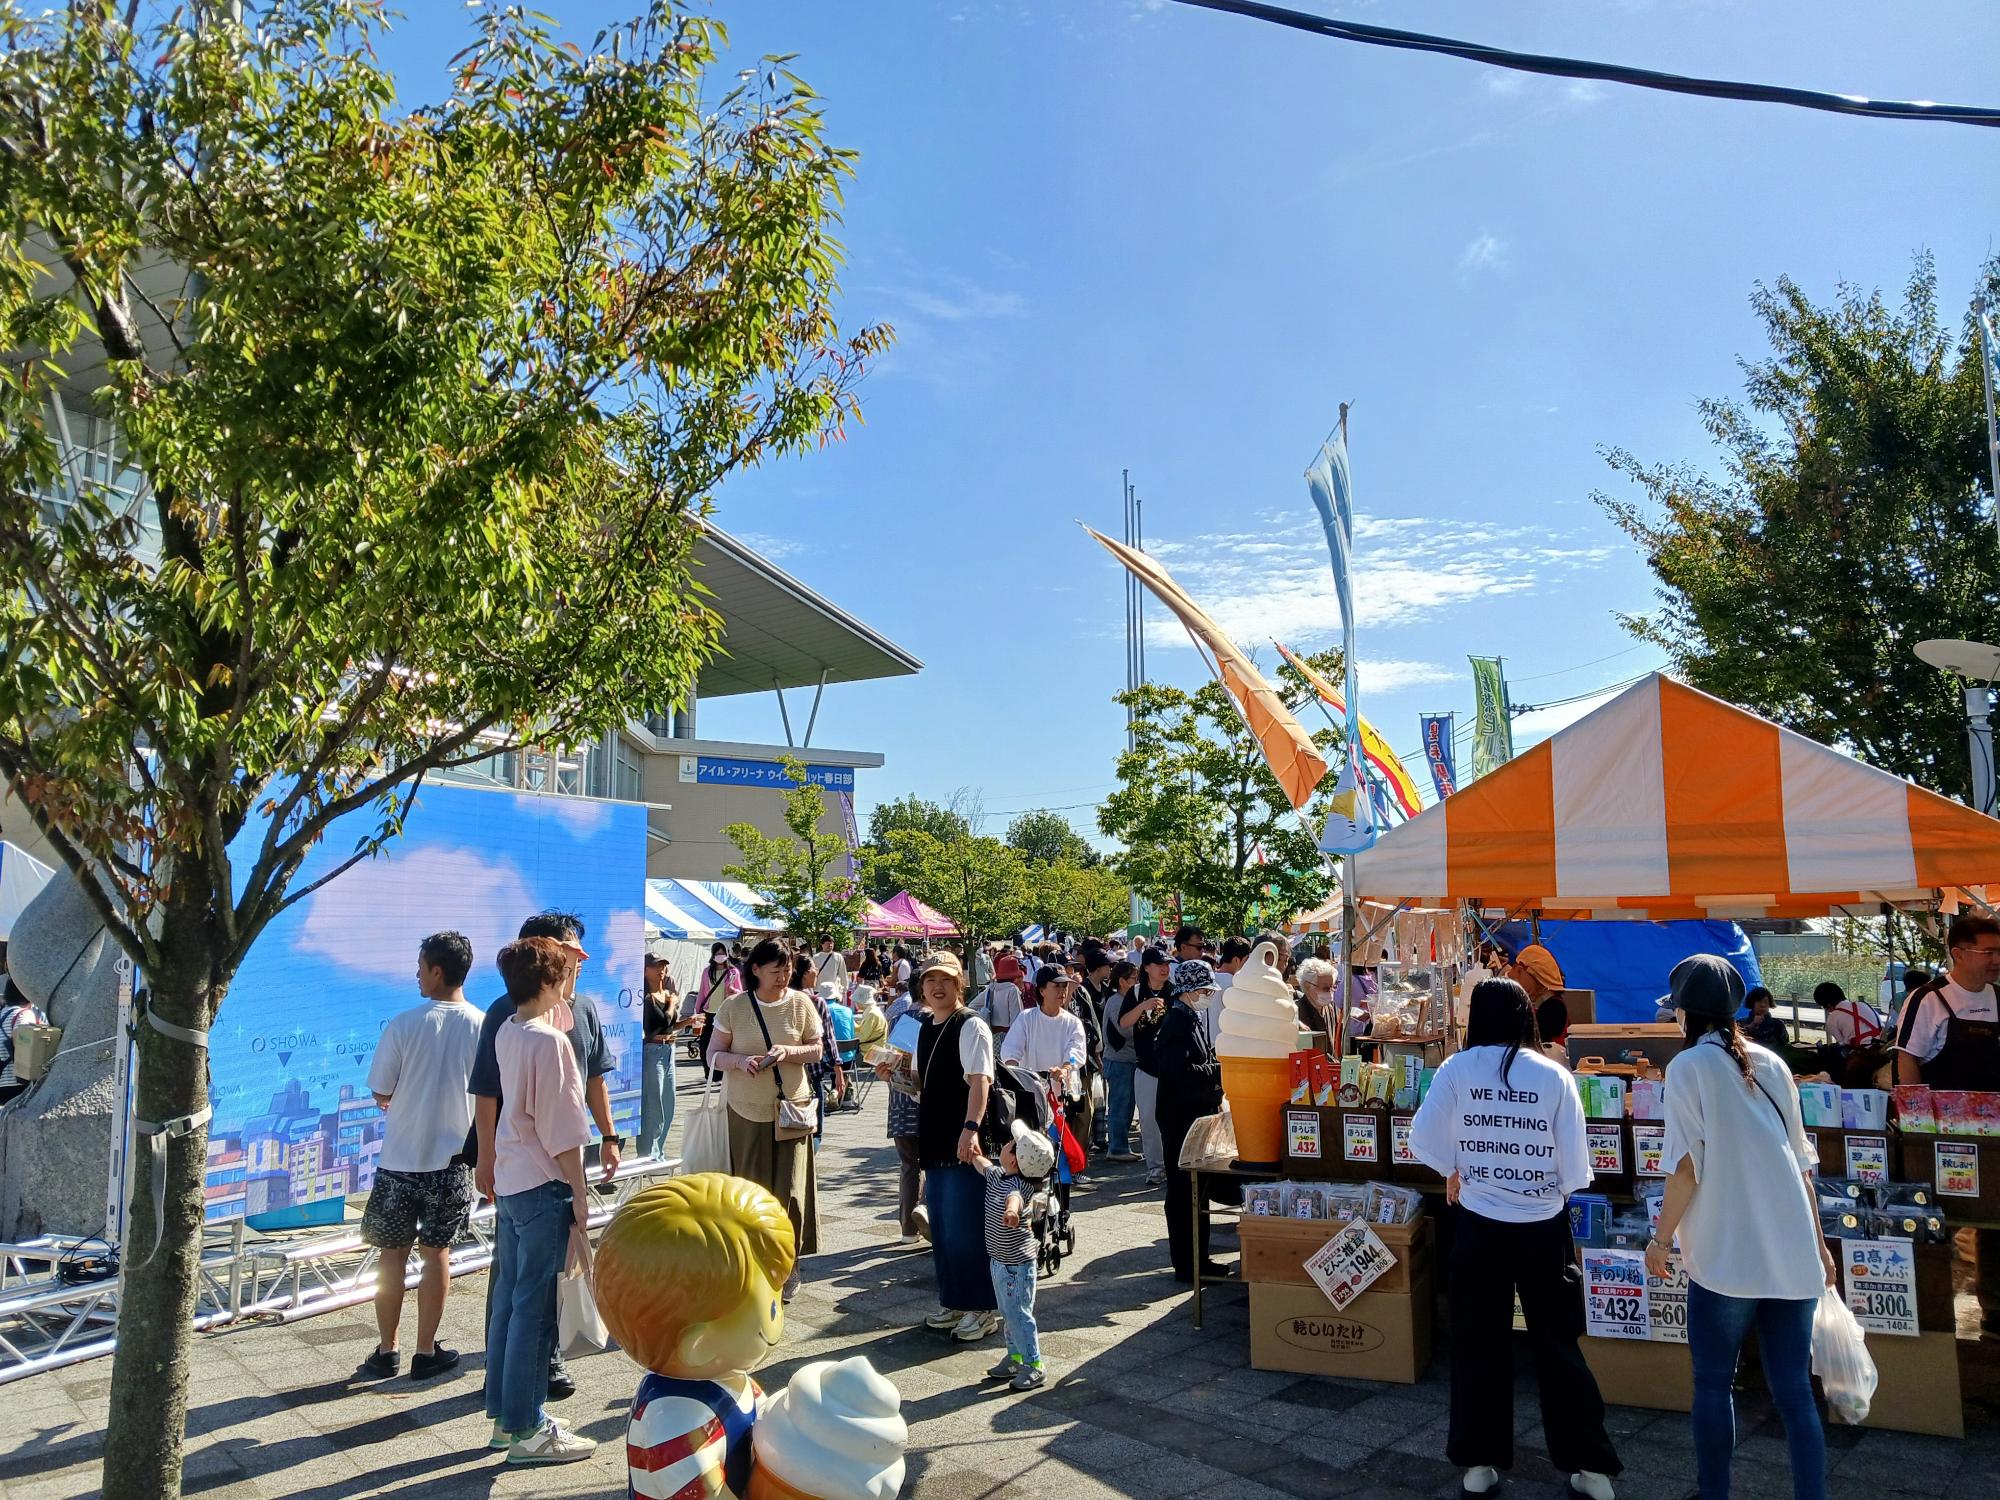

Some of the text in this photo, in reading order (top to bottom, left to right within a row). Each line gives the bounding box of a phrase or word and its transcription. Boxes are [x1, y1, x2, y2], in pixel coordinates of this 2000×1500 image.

[698, 764, 765, 779] アイル・アリーナ
[270, 1034, 318, 1050] SHOWA
[349, 1041, 377, 1053] SHOW
[1470, 1088, 1539, 1104] WE NEED
[1524, 1144, 1555, 1158] OUT
[1589, 1139, 1617, 1149] みどり
[1595, 1156, 1616, 1168] 259
[1948, 1177, 1974, 1191] 864
[1852, 1248, 1883, 1264] 日高
[1589, 1266, 1640, 1284] 青のり粉
[1869, 1264, 1909, 1280] こんぶ
[1664, 1276, 1688, 1289] こん
[1293, 1320, 1365, 1340] 乾しいたけ
